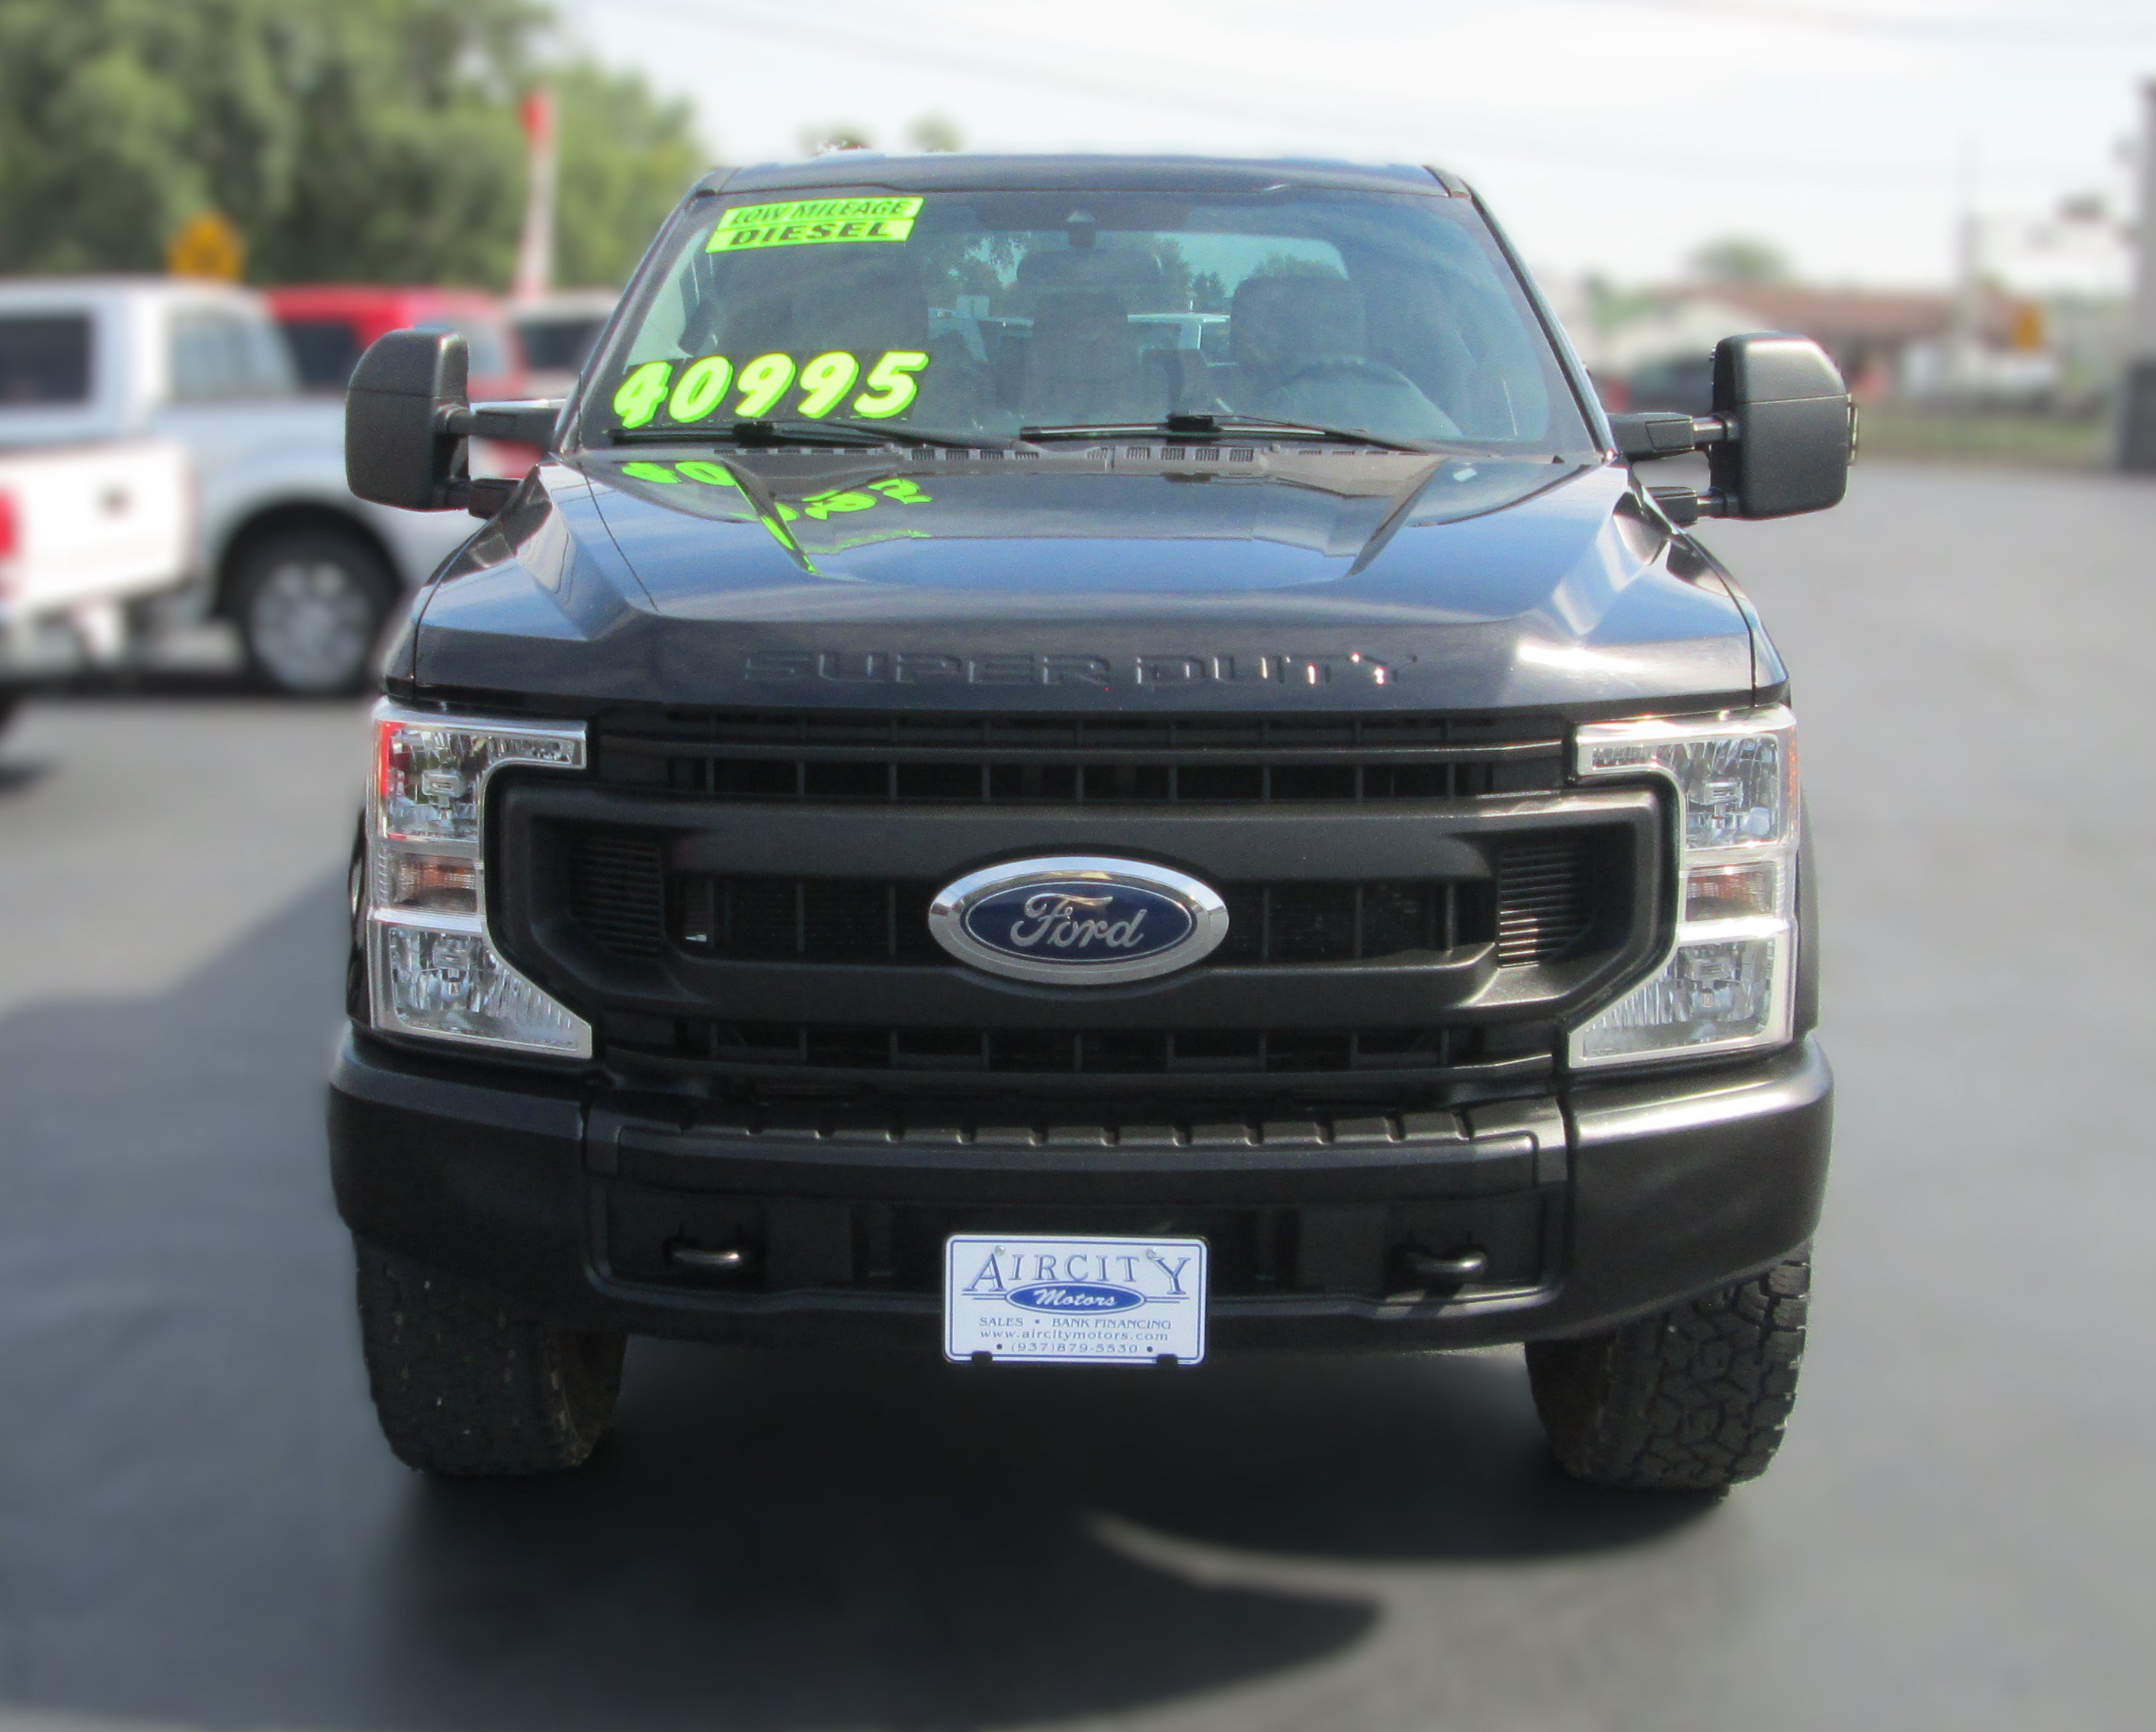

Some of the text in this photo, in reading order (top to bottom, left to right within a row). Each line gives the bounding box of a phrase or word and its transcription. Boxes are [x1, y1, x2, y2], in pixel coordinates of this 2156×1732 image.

[732, 200, 912, 225] LOW MILEAGE
[730, 222, 890, 245] DIESEL
[613, 351, 929, 429] 40995
[744, 652, 1420, 686] SUPER DUTY
[1009, 892, 1147, 948] Ford
[961, 1252, 1191, 1295] AIRCITY
[1033, 1288, 1118, 1307] Motors
[979, 1317, 1172, 1329] SALES BANK FINANCING
[980, 1329, 1169, 1342] www.aircitymotors.com
[1011, 1342, 1138, 1354] (937)879-5530
